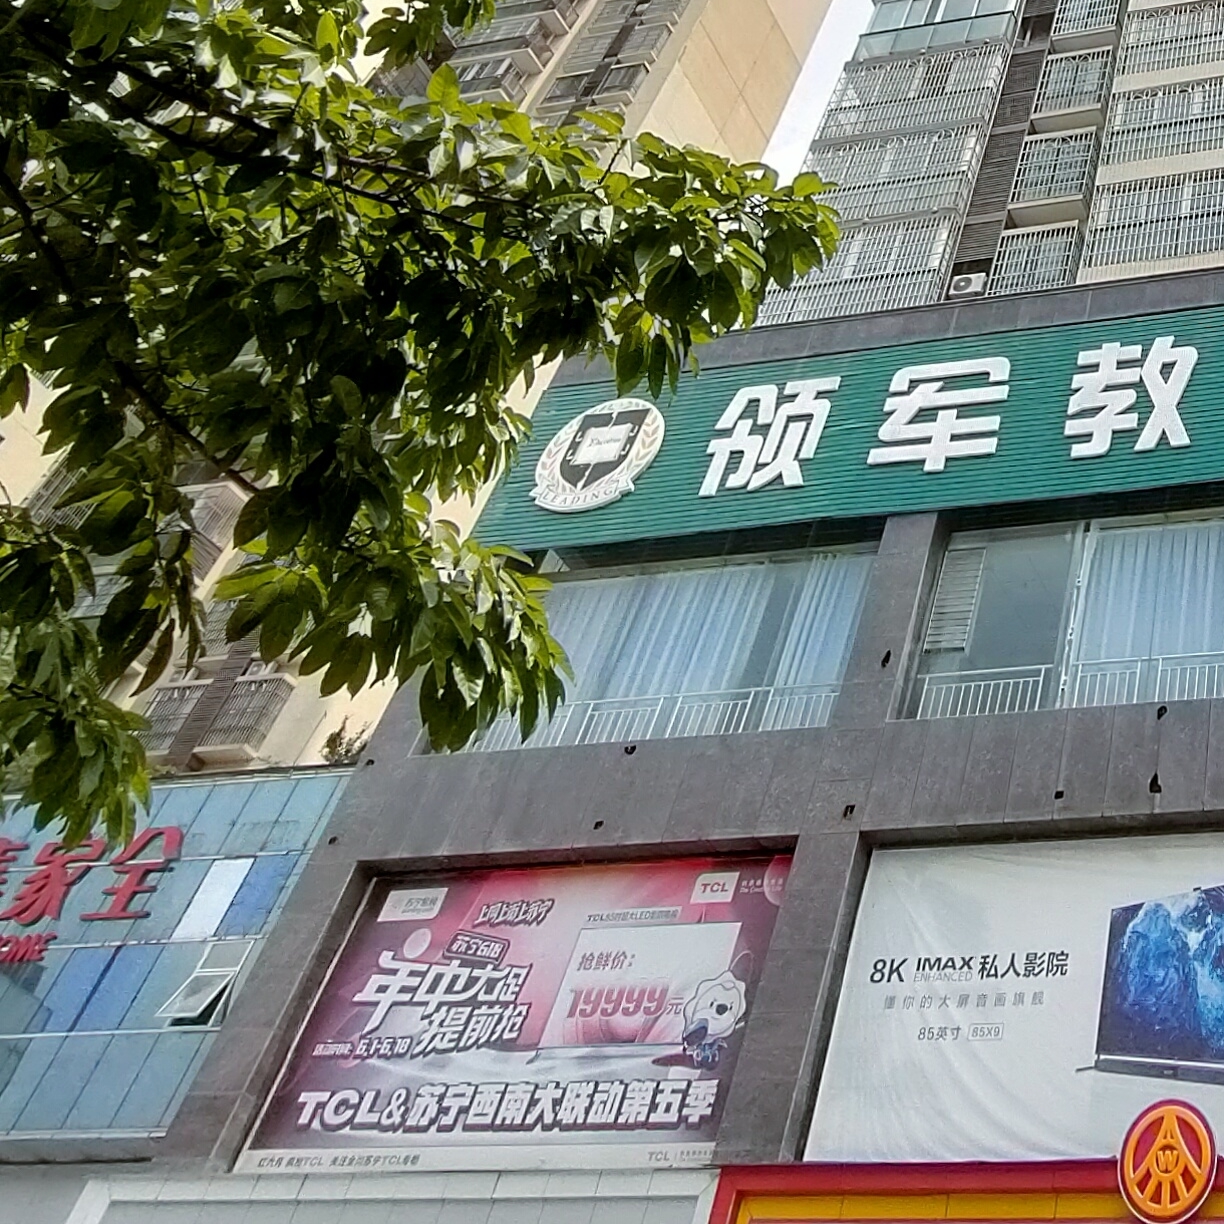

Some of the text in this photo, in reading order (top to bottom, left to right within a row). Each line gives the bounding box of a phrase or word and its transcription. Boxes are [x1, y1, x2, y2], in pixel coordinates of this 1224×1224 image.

[542, 487, 614, 505] LEADING
[0, 826, 184, 925] 家全
[700, 882, 730, 894] TCL
[452, 935, 504, 959] 苏宁618
[869, 950, 1069, 983] 8K IMAX 私人影院
[913, 971, 973, 982] ENHANCED
[352, 950, 531, 1034] 年中大促
[884, 991, 1045, 1010] 懂你的大屏音画旗舰
[412, 1003, 531, 1055] 提前抢
[917, 1025, 1000, 1041] 85英寸 85X9
[298, 1078, 719, 1132] TCL&苏宁西南大联动第五季
[648, 1151, 670, 1162] TCL
